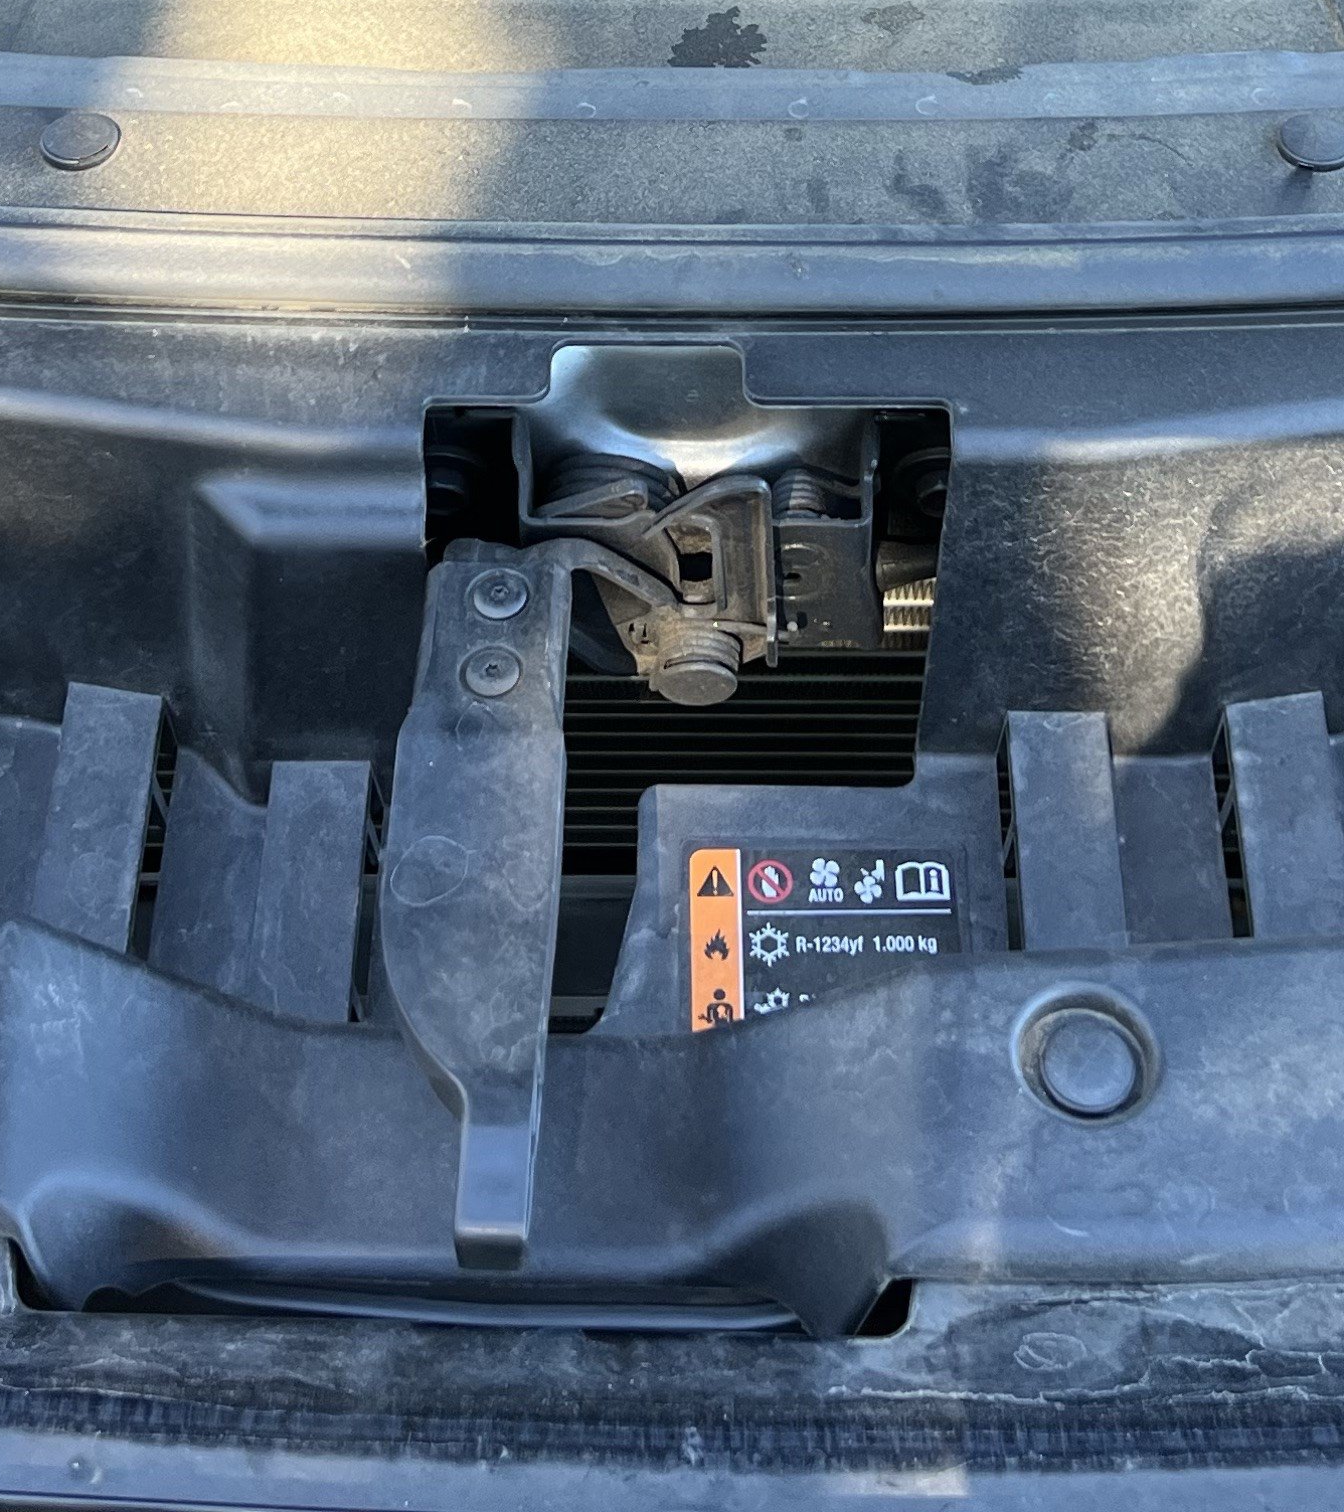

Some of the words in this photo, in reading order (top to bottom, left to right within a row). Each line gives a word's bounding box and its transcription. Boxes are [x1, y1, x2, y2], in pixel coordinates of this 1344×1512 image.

[808, 888, 844, 904] AUTO
[795, 936, 863, 956] R-1234yf
[872, 936, 915, 952] 1.000
[918, 935, 938, 955] kg
